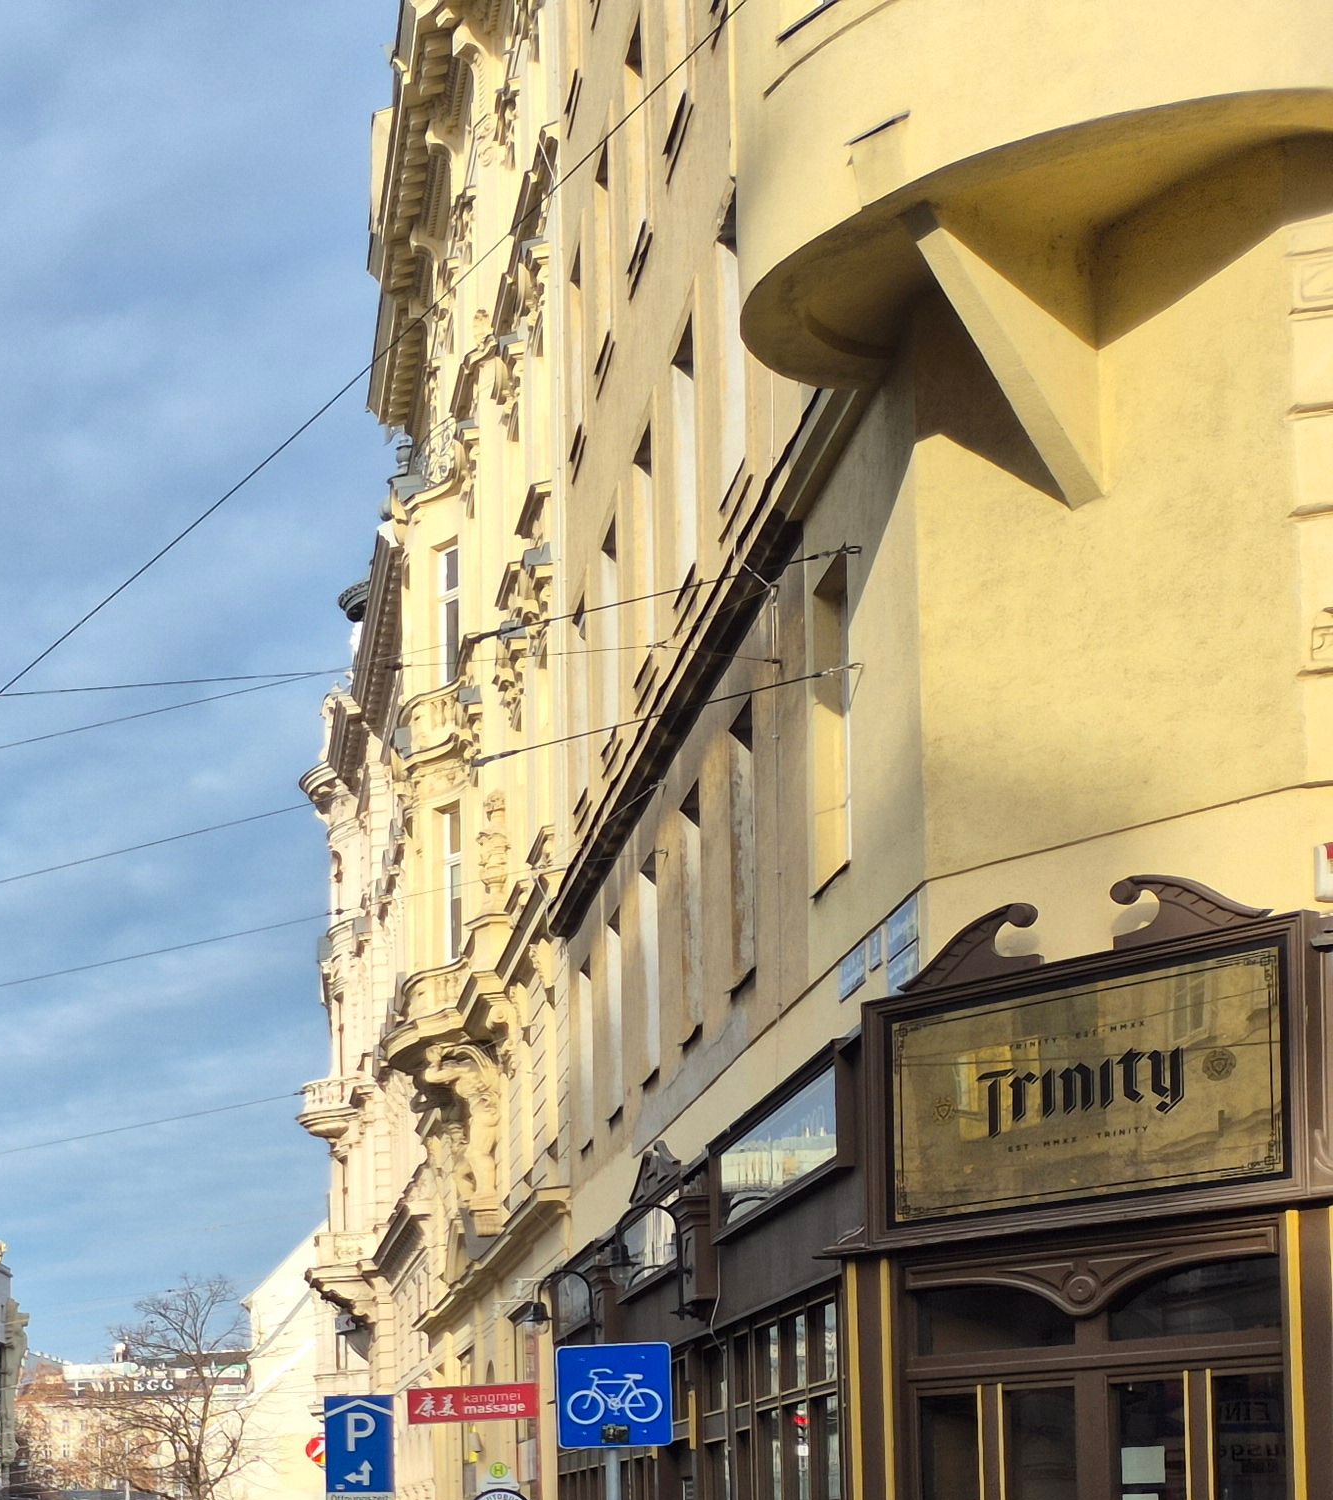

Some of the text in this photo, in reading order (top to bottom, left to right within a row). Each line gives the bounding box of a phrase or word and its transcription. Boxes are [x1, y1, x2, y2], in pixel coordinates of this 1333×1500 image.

[1010, 1020, 1145, 1050] TRINITY EST MMXX
[976, 1045, 1185, 1139] Trinity
[1007, 1143, 1029, 1153] EST
[1096, 1125, 1149, 1139] TRINITY
[462, 1391, 522, 1405] kangmei
[463, 1402, 526, 1415] massage
[346, 1412, 376, 1452] P
